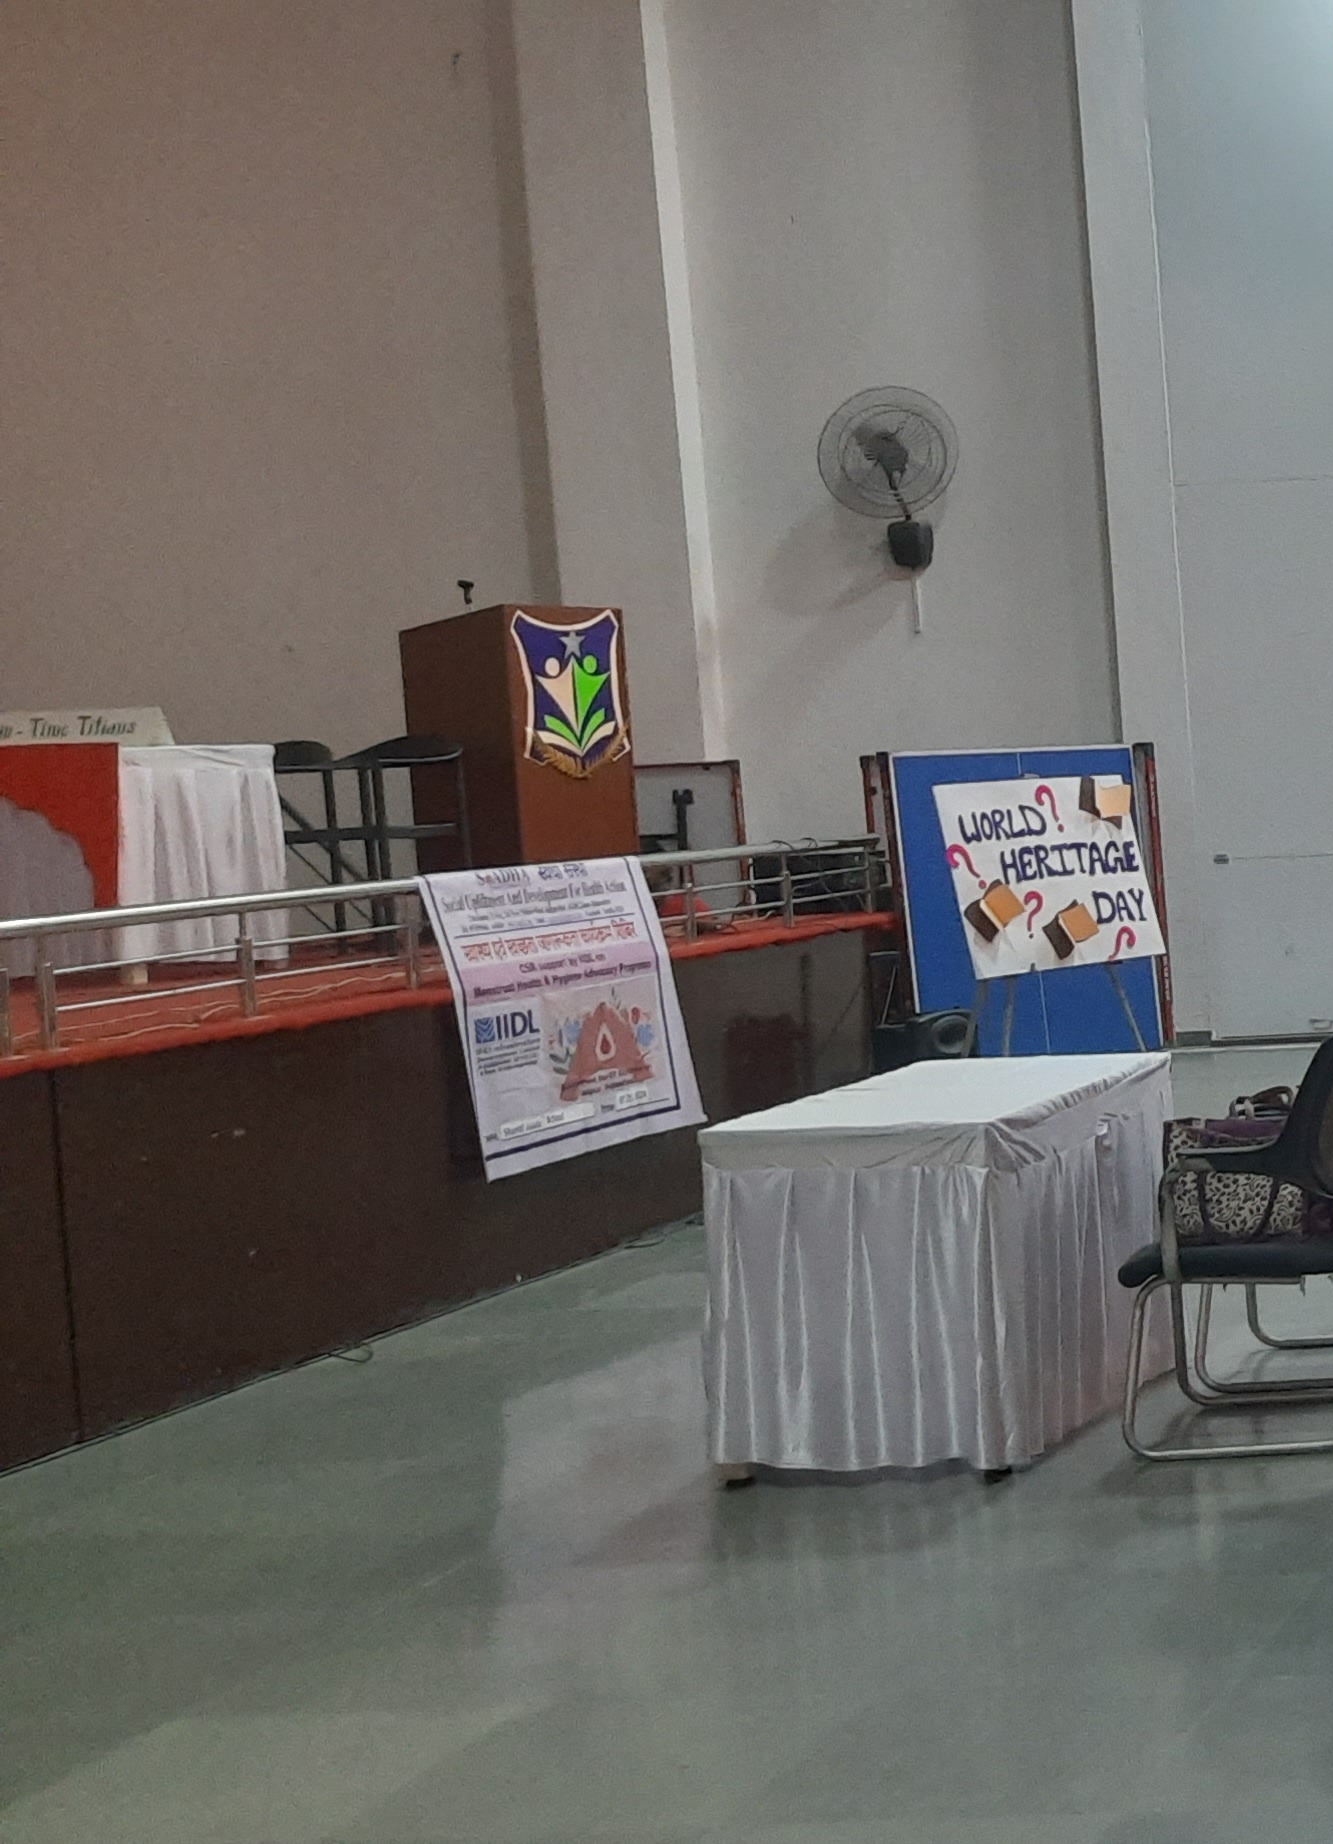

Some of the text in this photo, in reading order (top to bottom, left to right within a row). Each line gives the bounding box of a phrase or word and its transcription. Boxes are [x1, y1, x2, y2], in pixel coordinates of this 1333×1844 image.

[958, 804, 1047, 844] WORLD
[1000, 841, 1139, 884] HERITAGE
[1092, 888, 1147, 924] DAY
[496, 1009, 540, 1040] IIDL
